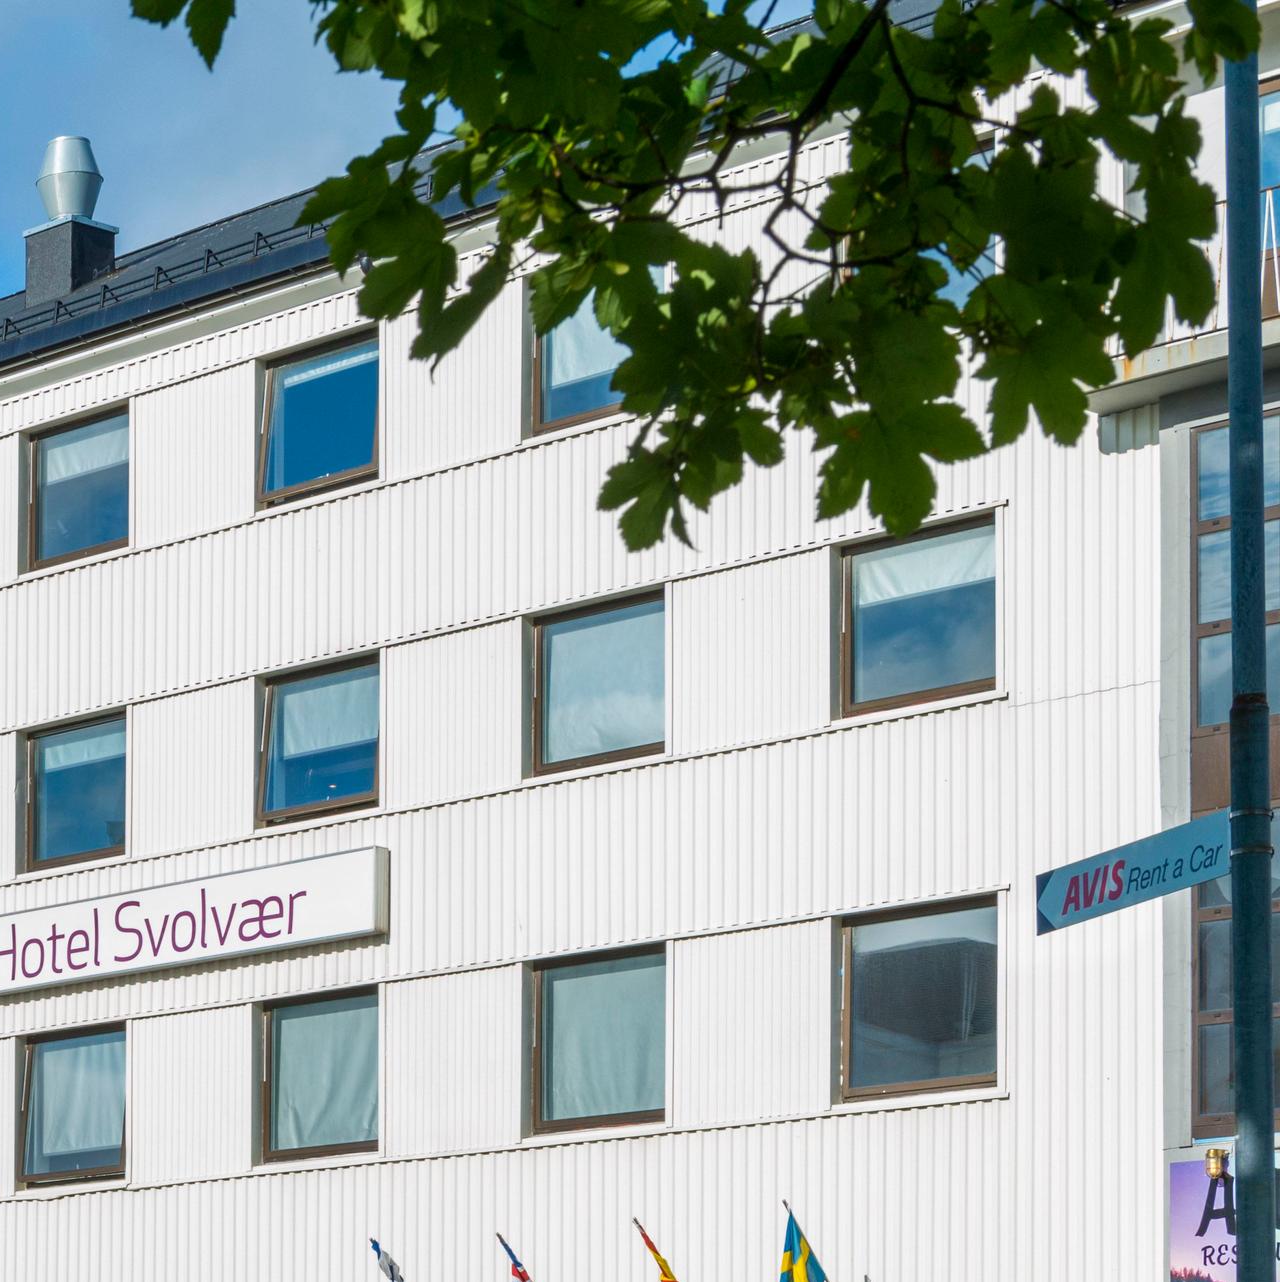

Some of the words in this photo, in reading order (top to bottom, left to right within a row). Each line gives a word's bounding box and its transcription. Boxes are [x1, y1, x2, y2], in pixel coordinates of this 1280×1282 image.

[1061, 859, 1125, 916] AVIS
[1126, 862, 1169, 895] Rent
[1172, 857, 1184, 878] a
[1190, 843, 1224, 873] Car
[113, 887, 308, 964] Svolvær
